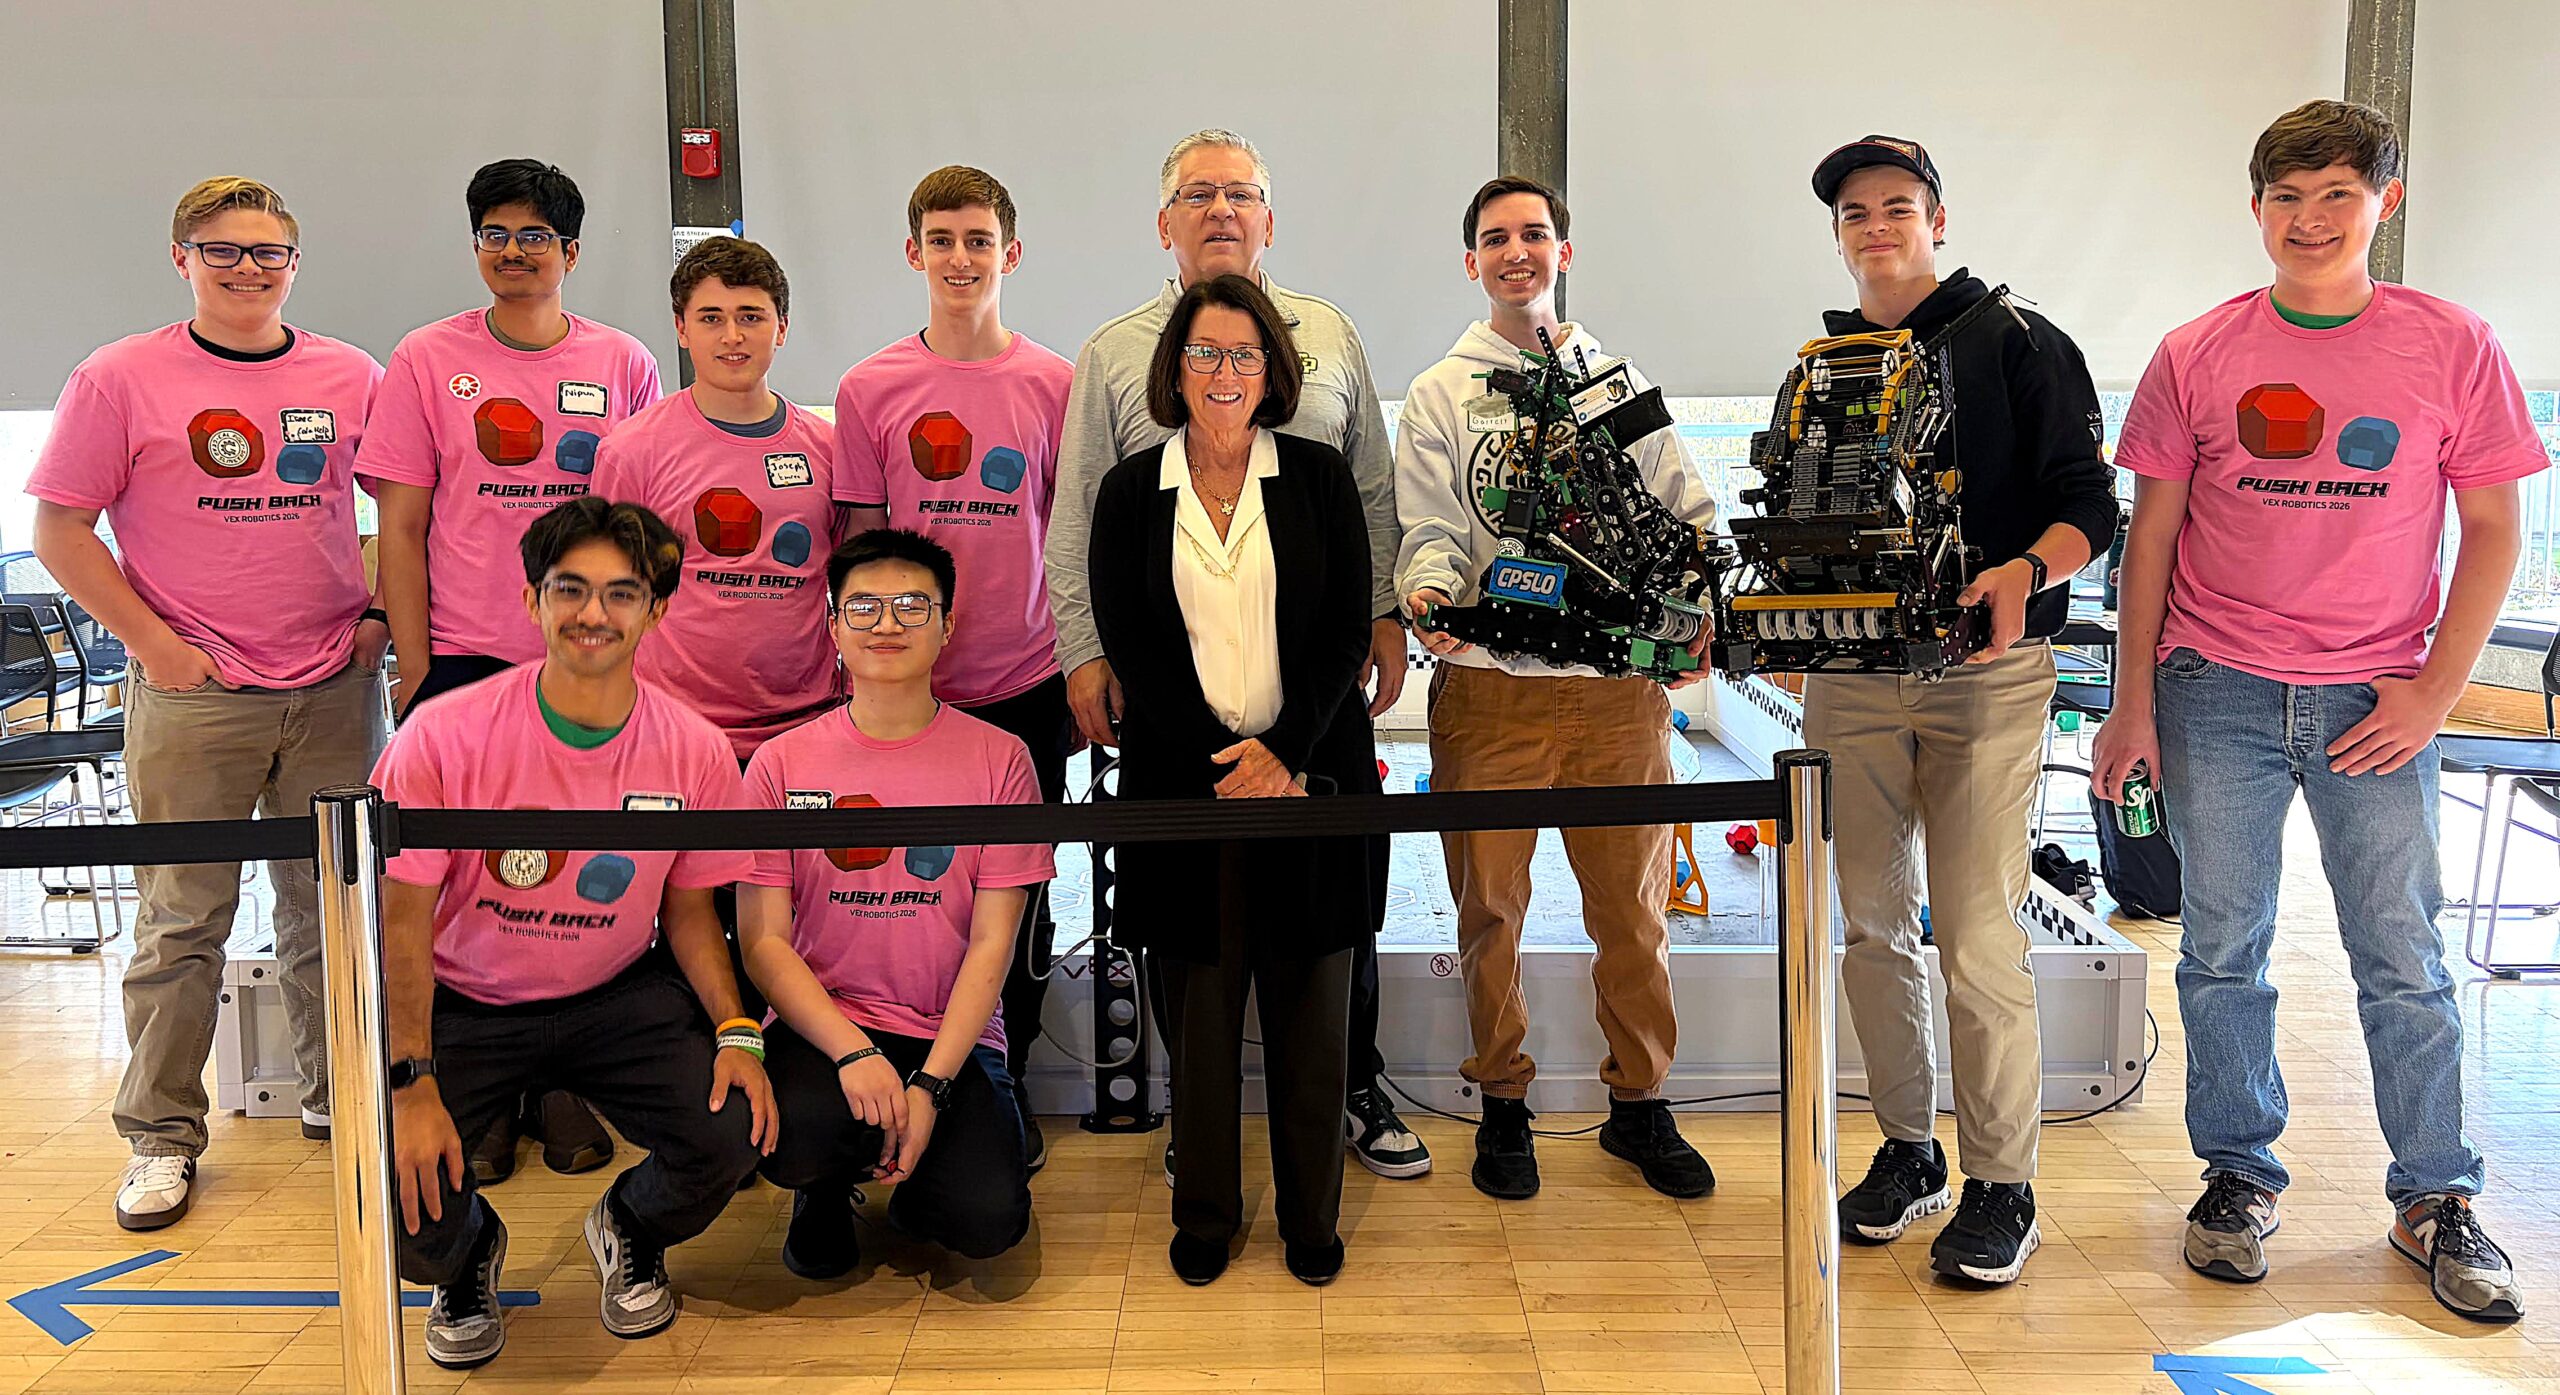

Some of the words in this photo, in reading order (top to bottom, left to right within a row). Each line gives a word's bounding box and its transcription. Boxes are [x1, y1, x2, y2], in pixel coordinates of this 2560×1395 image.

[564, 388, 595, 398] Nipun
[770, 462, 804, 472] Joseph
[477, 483, 539, 497] PUSH
[2236, 476, 2312, 496] PUSH
[2315, 480, 2391, 498] BACK
[197, 496, 265, 511] PUSH
[268, 494, 321, 509] BACK
[517, 501, 554, 509] ROBOTICS
[2262, 498, 2279, 507] VEX
[2281, 499, 2327, 510] ROBOTICS
[2328, 501, 2350, 510] 2026
[966, 501, 1020, 517] BACK
[223, 515, 241, 523] VEX
[241, 513, 281, 523] ROBOTICS
[282, 512, 300, 520] 2026
[943, 518, 976, 526] ROBOTICS
[696, 570, 755, 587] PUSH
[758, 574, 807, 590] BACK
[1497, 566, 1557, 595] CPSLO
[718, 590, 732, 598] VEX
[732, 590, 768, 599] ROBOTICS
[769, 592, 784, 600] 2026
[829, 889, 888, 906] PUSH
[890, 889, 942, 906] BACK
[850, 909, 863, 918] VEX
[863, 910, 899, 919] ROBOTICS
[899, 909, 917, 917] 2026
